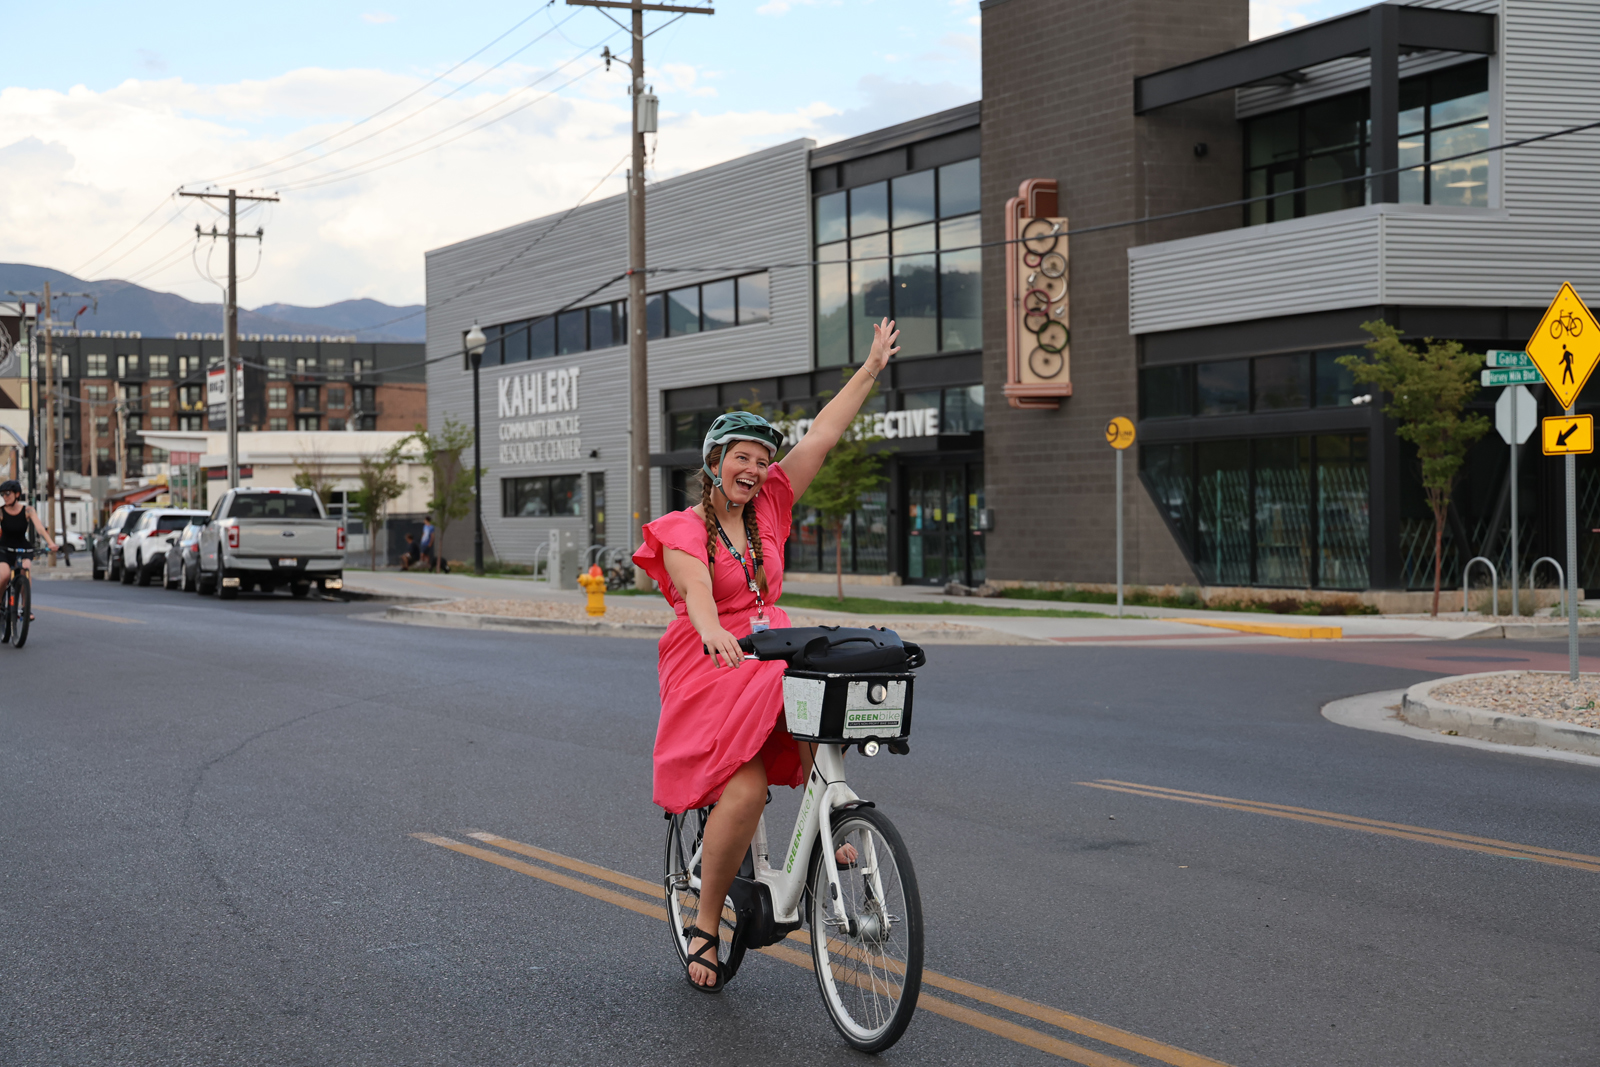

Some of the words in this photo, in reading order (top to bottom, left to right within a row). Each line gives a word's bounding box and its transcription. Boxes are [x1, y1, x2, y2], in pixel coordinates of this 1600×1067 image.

[1498, 353, 1518, 365] Gale
[1519, 353, 1528, 365] St
[1490, 373, 1508, 384] Harvey
[1508, 371, 1522, 381] Milk
[1523, 370, 1536, 381] Blvd
[498, 367, 580, 418] KAHLERT
[499, 421, 546, 441] COMMUNITY
[547, 416, 581, 436] BICYCLE
[842, 408, 939, 442] LLECTIVE
[1106, 422, 1119, 443] 9
[499, 441, 545, 464] RESOURCE
[545, 437, 581, 462] CENTER
[849, 711, 900, 721] GREENbike
[787, 799, 811, 874] GREENbike
